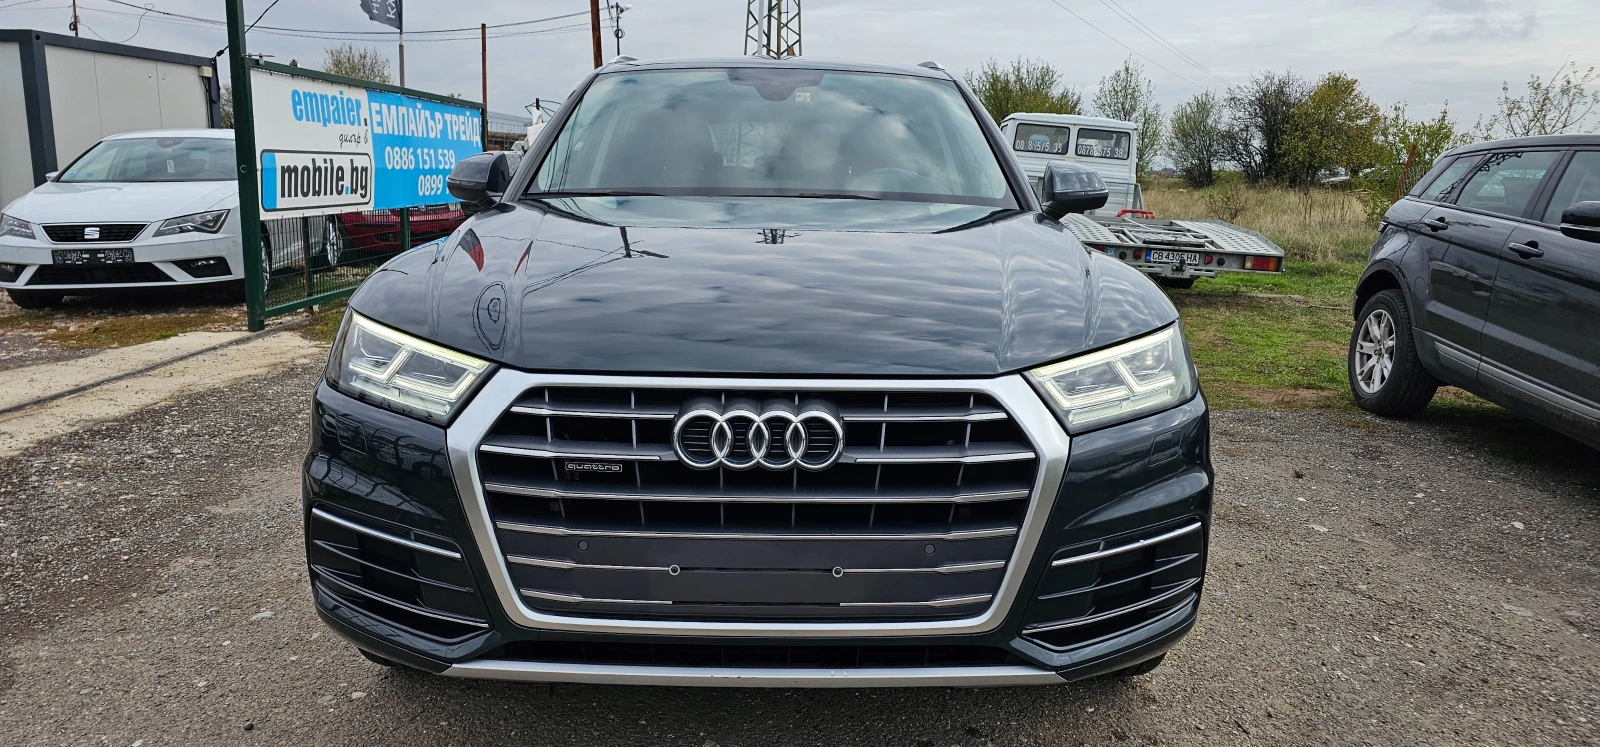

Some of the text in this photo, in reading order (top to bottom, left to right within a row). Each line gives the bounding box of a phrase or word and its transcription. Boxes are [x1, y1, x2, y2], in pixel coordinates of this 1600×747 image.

[371, 103, 481, 147] ЕМПАЙЪР ТРЕЙД
[385, 146, 456, 170] 0886 151 539
[280, 158, 369, 199] mobile.bg
[418, 174, 443, 197] 0899
[567, 463, 620, 471] quattro
